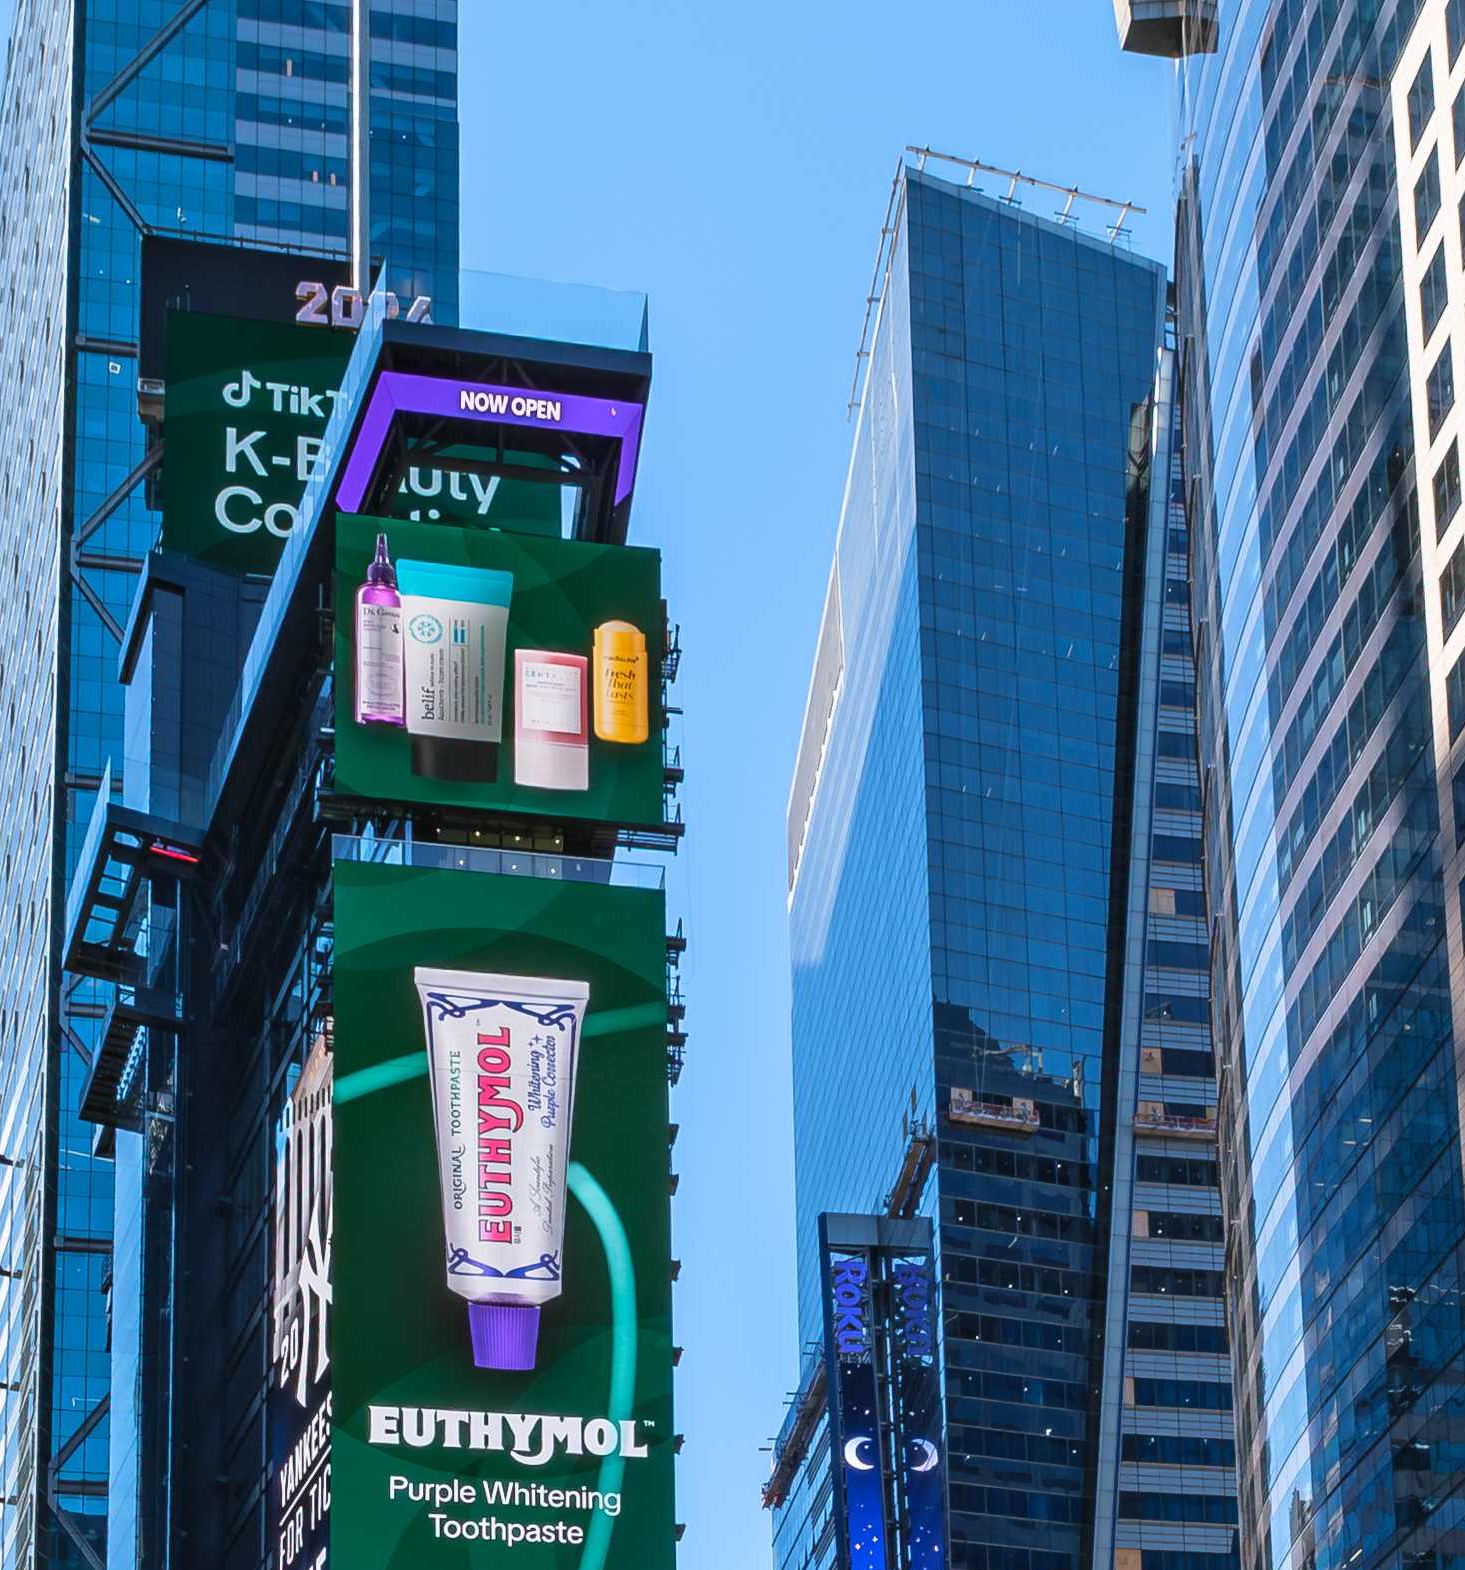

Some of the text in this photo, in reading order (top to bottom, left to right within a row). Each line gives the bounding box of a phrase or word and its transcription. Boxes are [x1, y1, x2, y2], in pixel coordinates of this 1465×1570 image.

[460, 390, 561, 422] NOW OPEN
[421, 686, 435, 721] belif
[528, 1050, 542, 1112] Whitening
[540, 1086, 559, 1129] Purple
[450, 1050, 466, 1210] ORIGINAL TOOTHPASTE
[477, 1026, 524, 1244] EUTHYMOL
[389, 1475, 622, 1517] Purple Whitening
[428, 1512, 584, 1546] Toothpaste
